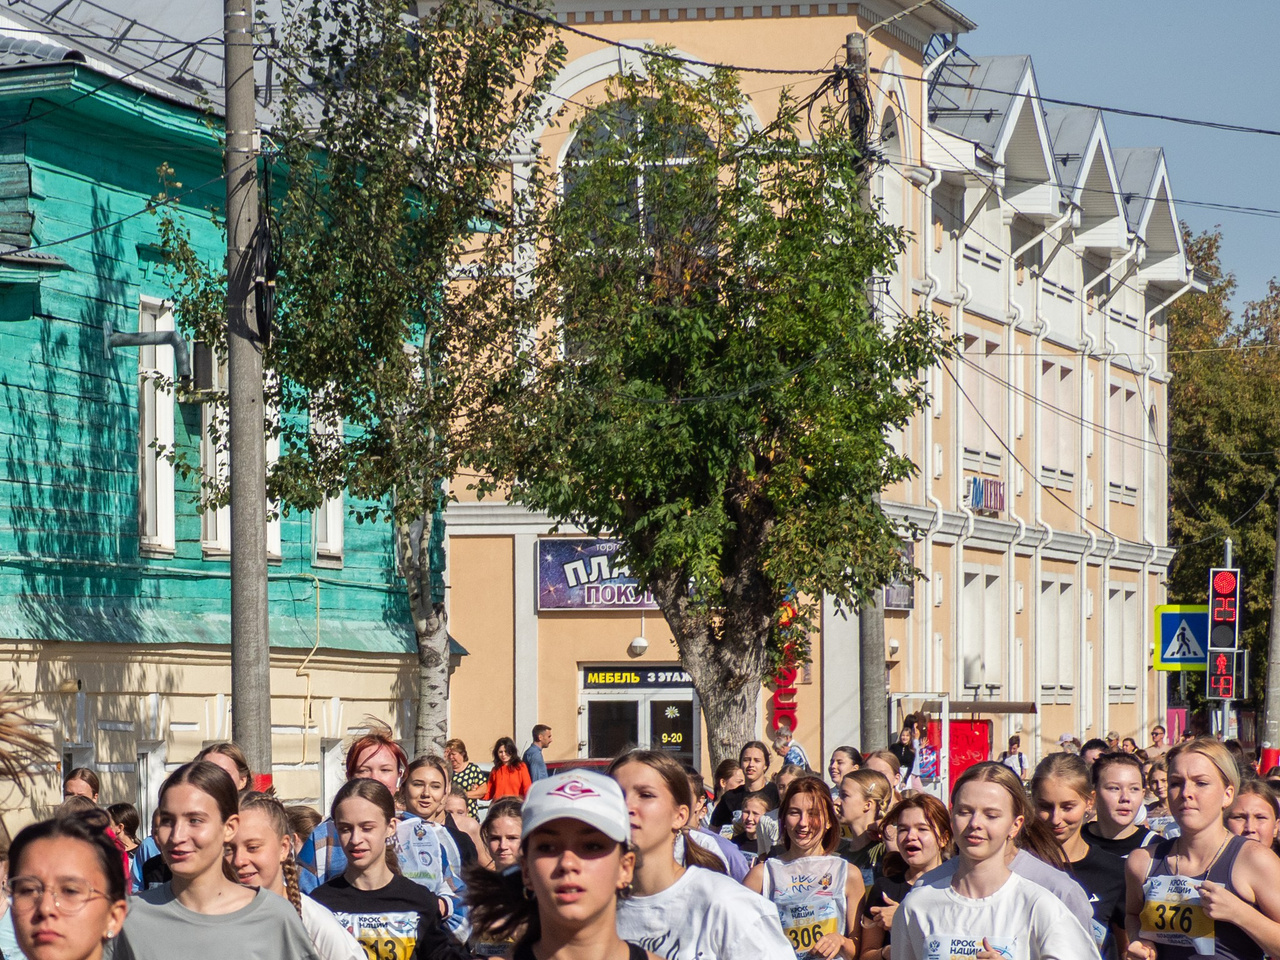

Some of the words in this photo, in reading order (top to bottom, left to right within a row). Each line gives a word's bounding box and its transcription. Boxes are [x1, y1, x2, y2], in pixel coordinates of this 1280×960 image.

[563, 555, 631, 588] ПЛА
[1214, 597, 1235, 621] 25
[587, 672, 640, 684] МЕБЕЛЬ
[647, 672, 656, 683] 3
[661, 733, 683, 743] 9-20
[1169, 879, 1187, 887] КРОСС
[1167, 886, 1192, 894] НАЦИИ
[1154, 904, 1193, 933] 376
[789, 924, 823, 950] 306
[951, 939, 976, 947] КРОСС
